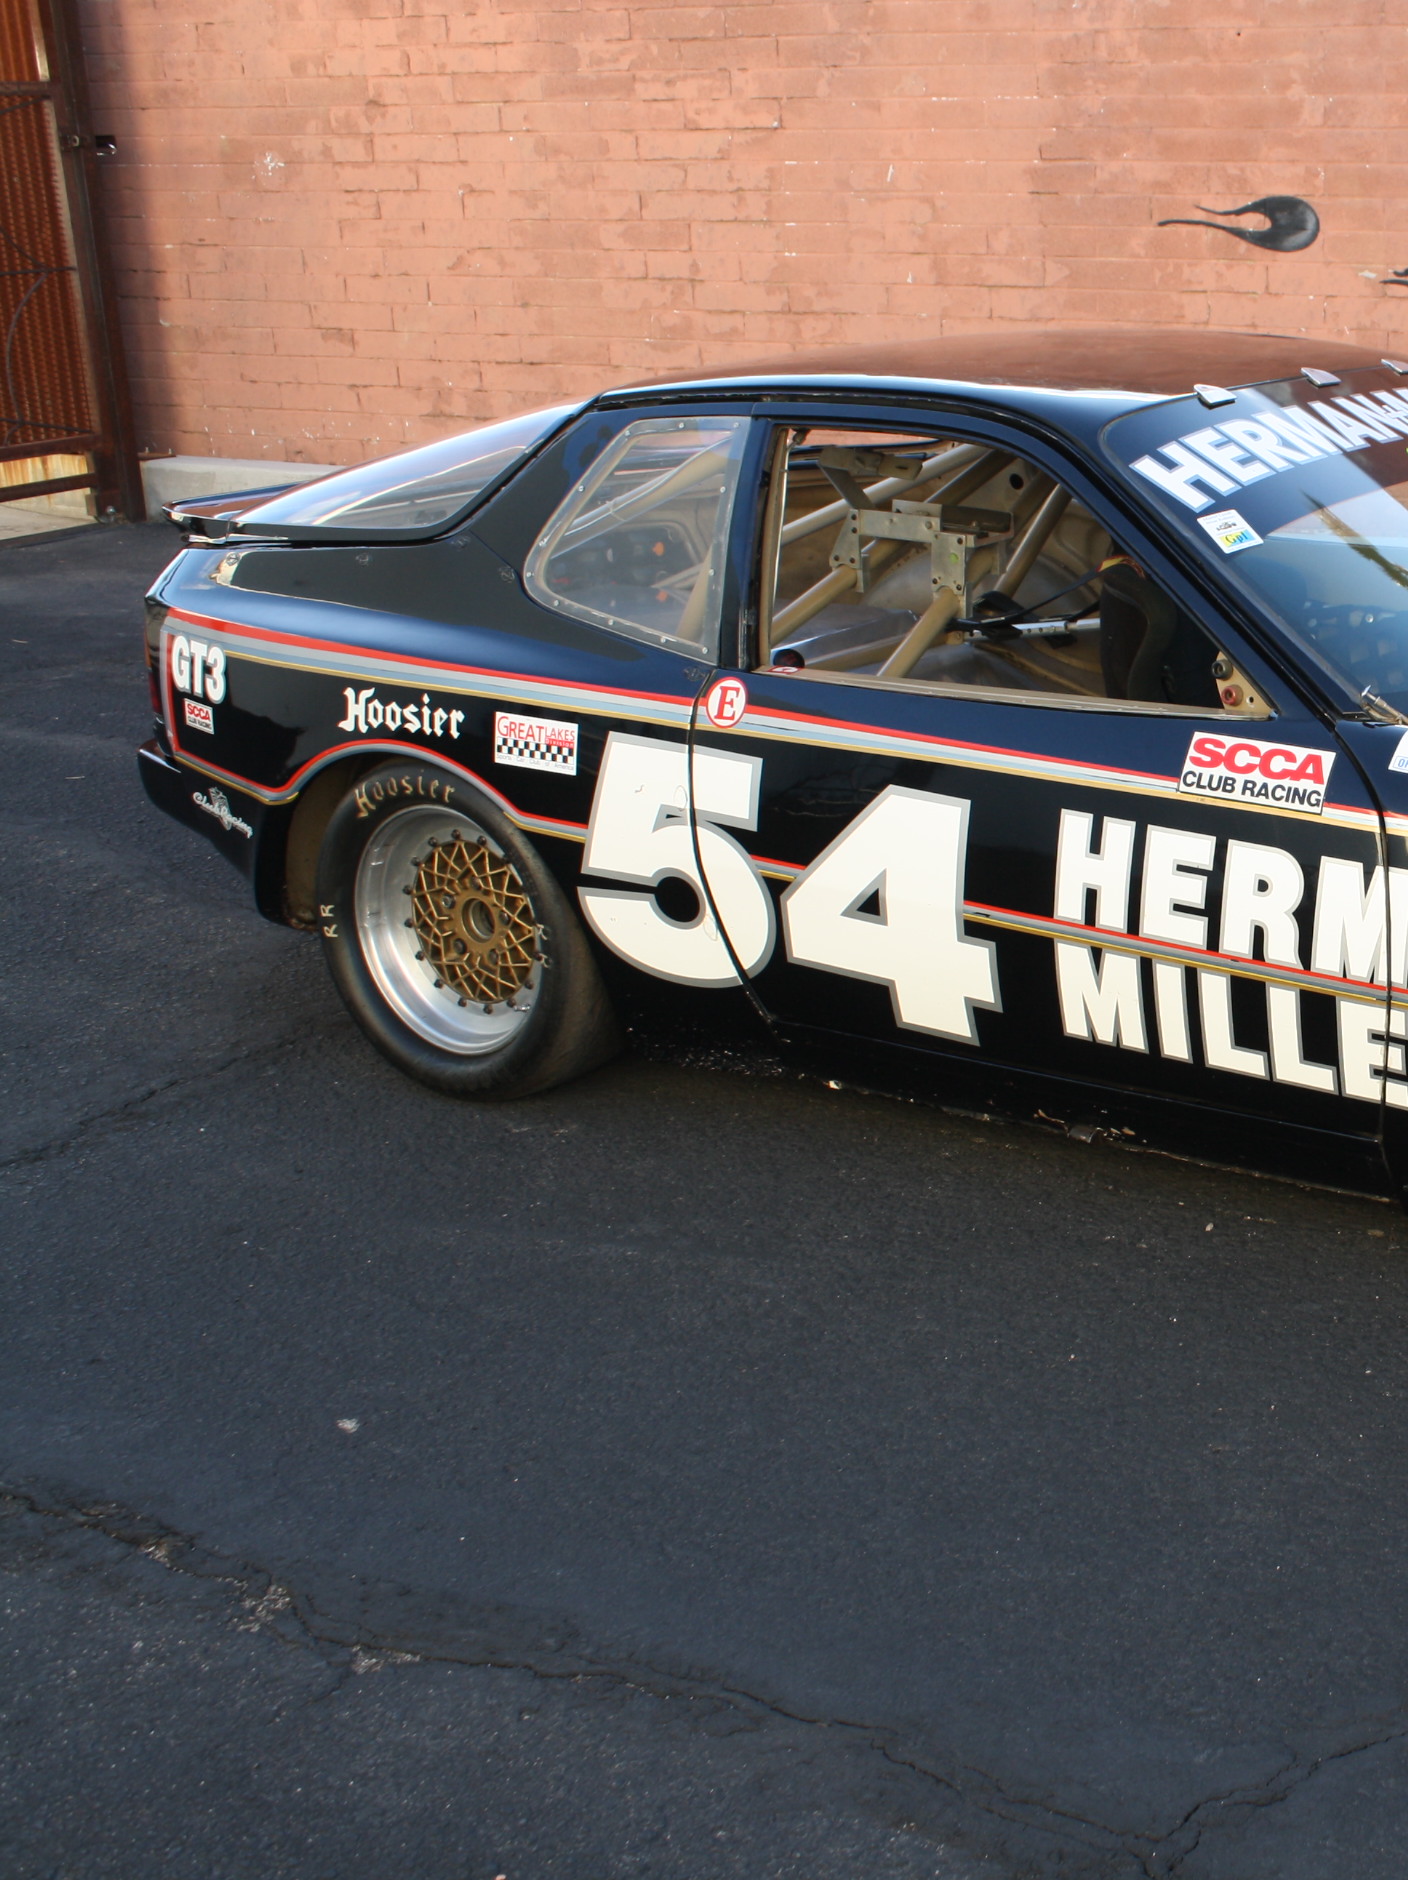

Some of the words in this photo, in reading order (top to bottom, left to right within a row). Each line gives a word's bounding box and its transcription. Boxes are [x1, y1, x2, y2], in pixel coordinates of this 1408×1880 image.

[171, 635, 227, 704] GT3
[187, 704, 210, 720] SCCA
[337, 686, 465, 739] Hoosier
[713, 685, 741, 721] E
[497, 715, 544, 743] GREAT
[544, 727, 575, 741] LAKES
[1188, 737, 1325, 785] SCCA
[354, 768, 455, 819] Hoosier
[1182, 771, 1236, 794] CLUB
[1241, 779, 1322, 808] RACING
[577, 731, 1003, 1046] 54
